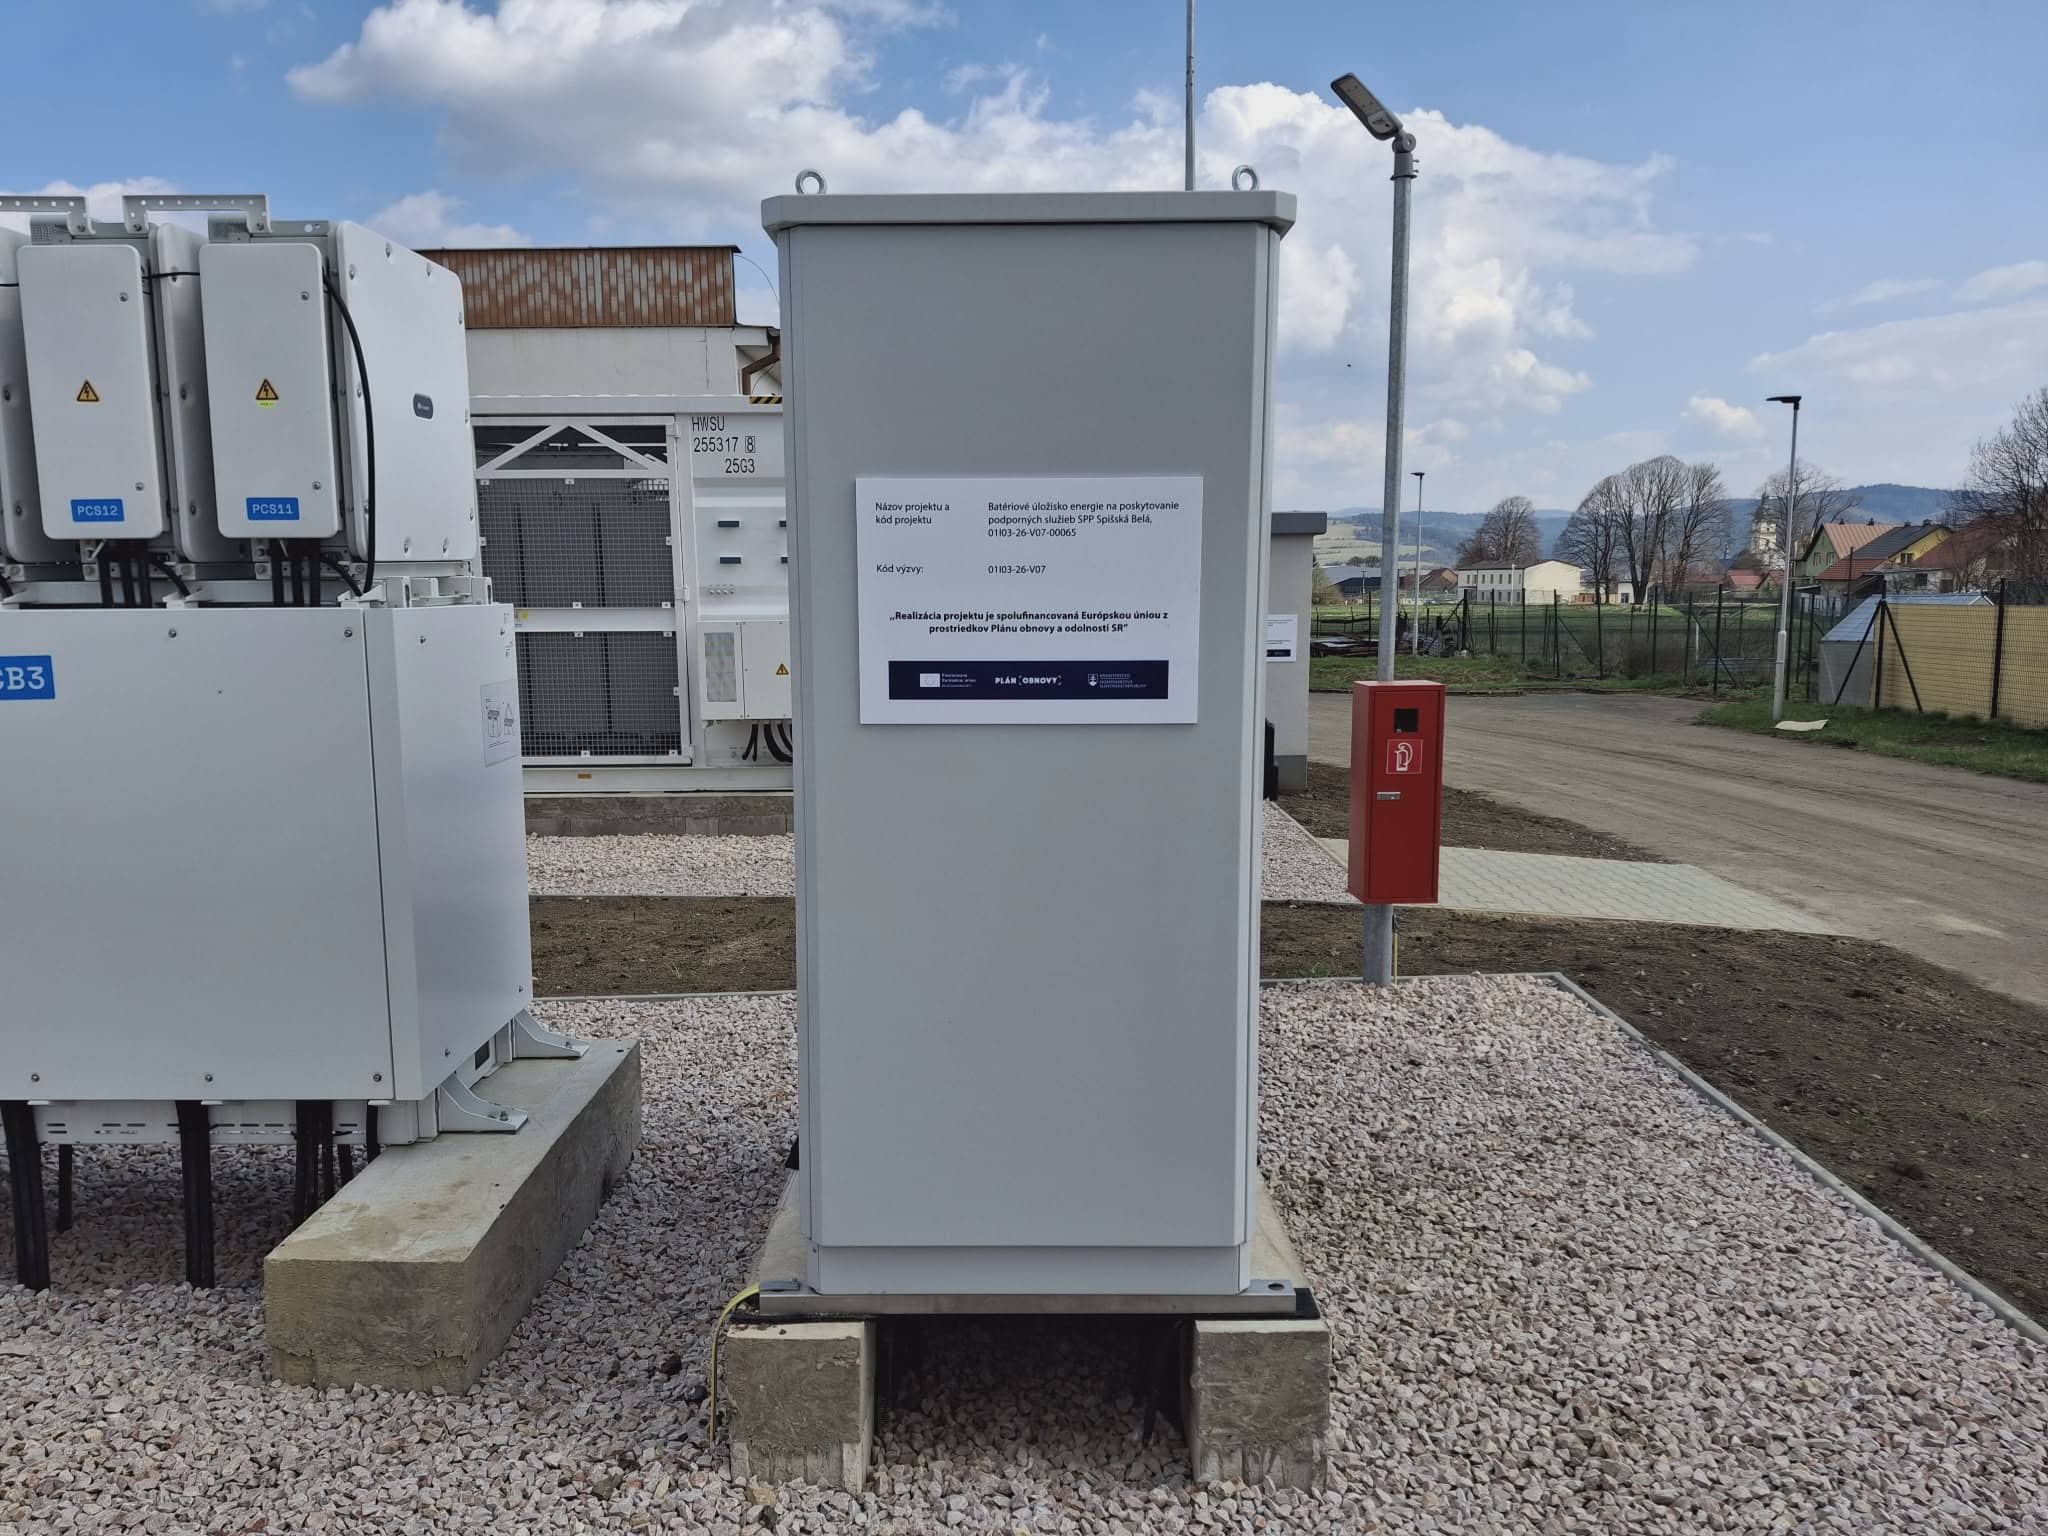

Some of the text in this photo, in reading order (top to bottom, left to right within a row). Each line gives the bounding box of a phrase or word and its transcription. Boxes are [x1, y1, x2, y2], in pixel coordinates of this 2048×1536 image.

[691, 415, 725, 432] HWSU
[693, 436, 754, 453] 255317 8
[725, 458, 755, 473] 25G3
[77, 505, 119, 516] PCS12
[252, 503, 293, 515] PCS11
[875, 502, 902, 511] Názov
[905, 502, 943, 513] projektu
[988, 501, 1179, 513] Batériové úložisko energie na poskytovanie
[875, 515, 932, 526] kód projektu
[988, 515, 1042, 526] podporných
[1044, 515, 1075, 524] služieb
[1077, 515, 1094, 524] SPP
[1096, 514, 1129, 525] Spišská
[876, 564, 924, 575] Kód výzvy:
[944, 611, 983, 622] projektu
[985, 611, 996, 622] je
[996, 611, 1079, 622] spolufinancovaná
[1081, 611, 1131, 621] Európskou
[1134, 611, 1160, 620] úniou
[929, 624, 989, 635] prostriedkov
[991, 624, 1017, 633] Plánu
[1019, 624, 1055, 634] obnovy
[1064, 624, 1109, 632] odolnosti
[0, 666, 45, 690] B3
